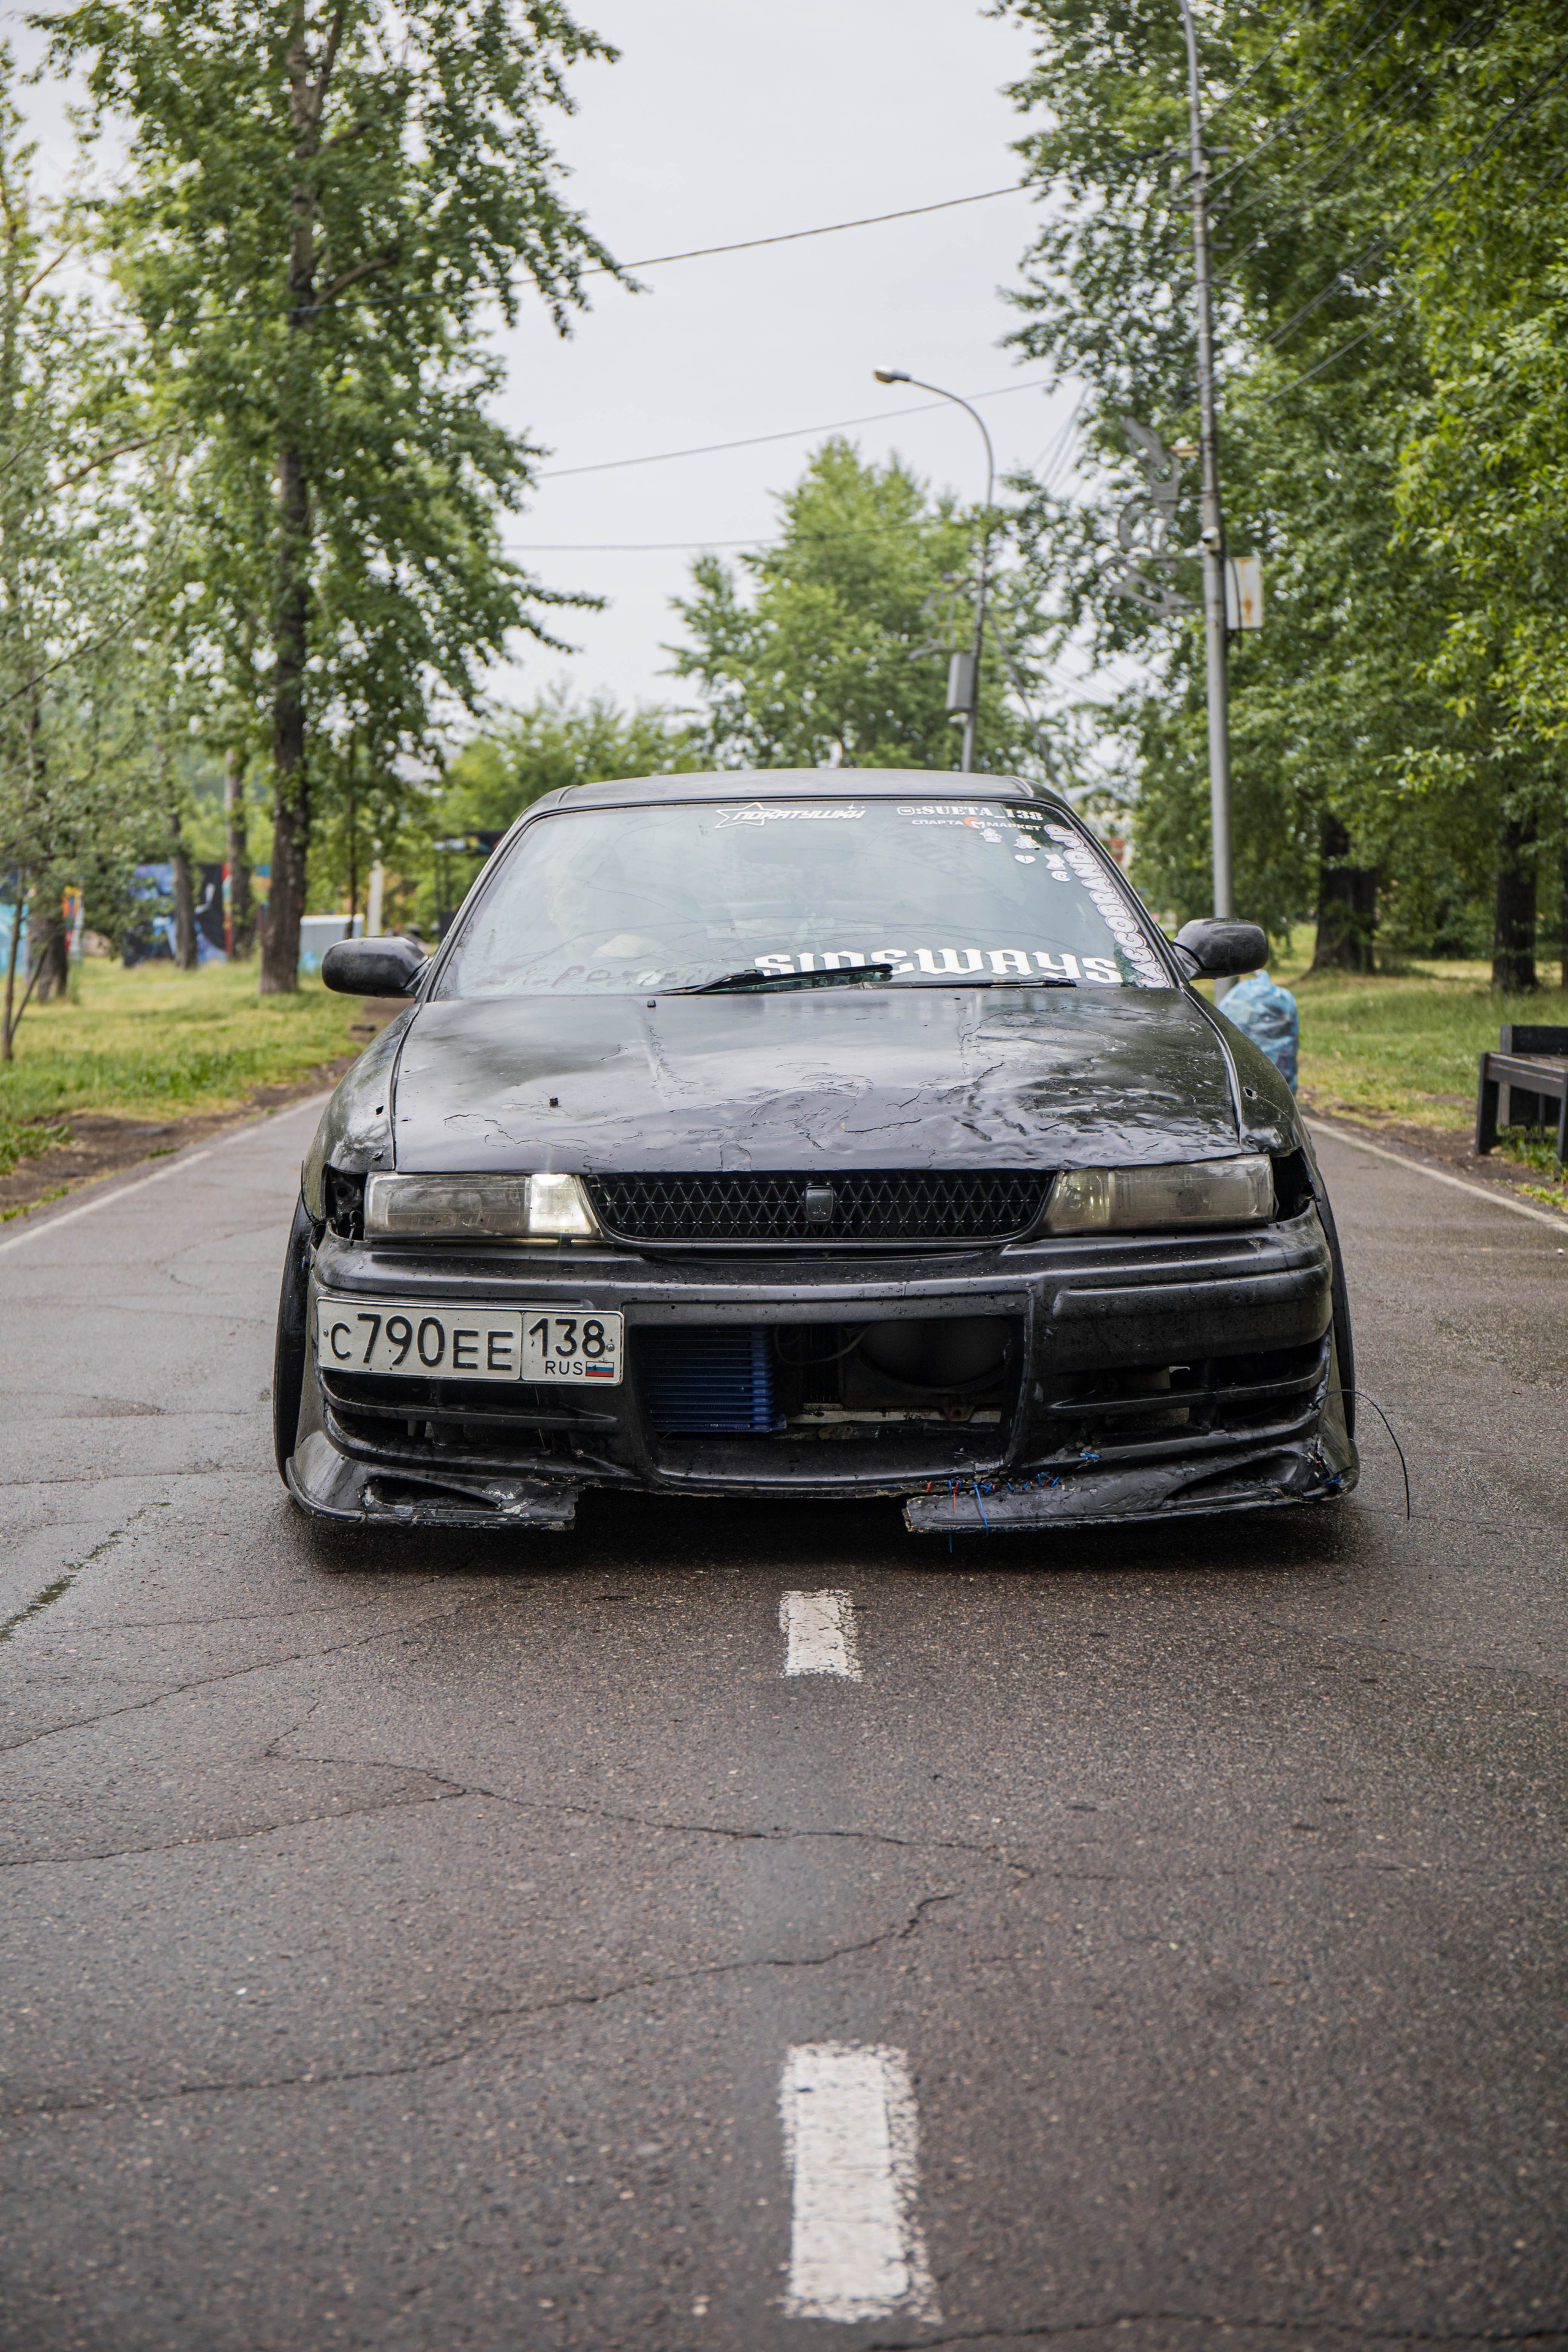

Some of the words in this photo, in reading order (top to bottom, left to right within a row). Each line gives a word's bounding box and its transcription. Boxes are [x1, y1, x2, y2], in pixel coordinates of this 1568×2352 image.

[986, 821, 1041, 831] МАРКЕТ
[528, 1317, 606, 1359] 138
[545, 1360, 583, 1376] RUS
